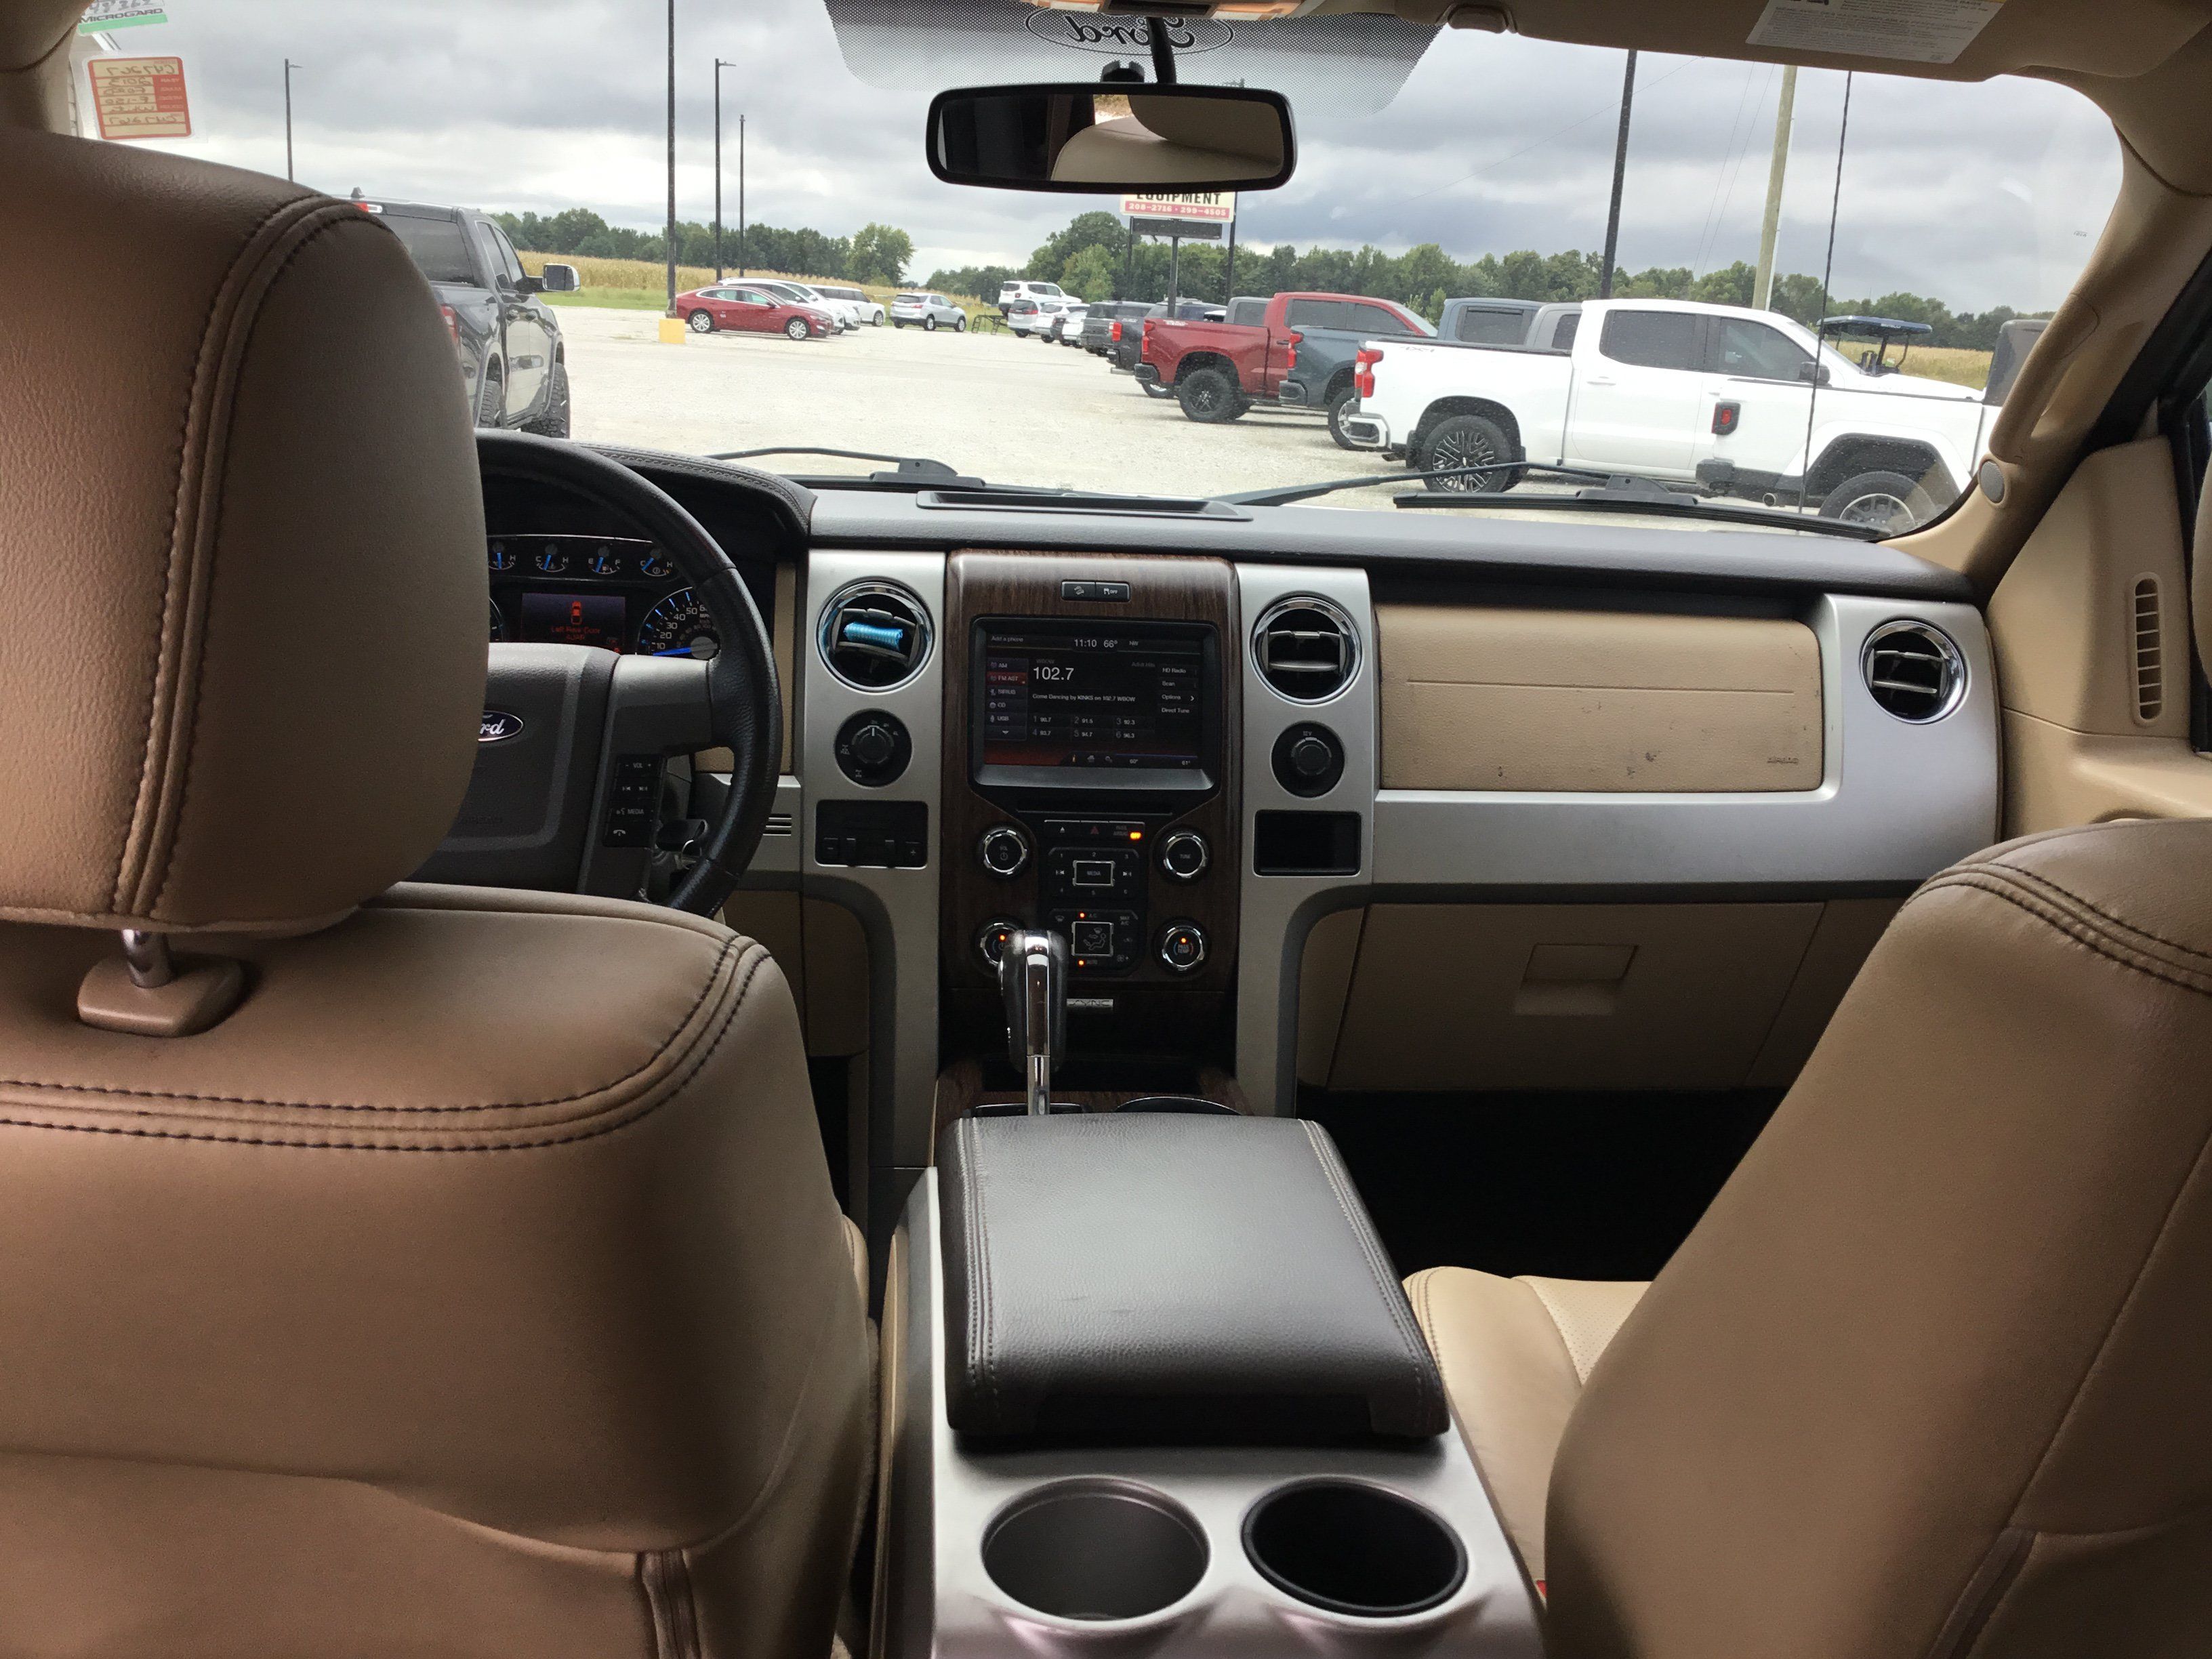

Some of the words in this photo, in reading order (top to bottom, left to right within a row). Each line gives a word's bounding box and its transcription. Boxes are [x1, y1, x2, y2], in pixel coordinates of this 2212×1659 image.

[1180, 207, 1226, 216] 299-4505
[686, 607, 698, 615] 50
[674, 613, 686, 621] 40
[666, 621, 678, 630] 30
[656, 642, 665, 650] 10
[1074, 639, 1097, 648] 11:10
[1033, 667, 1074, 681] 102.7
[476, 718, 506, 735] rd
